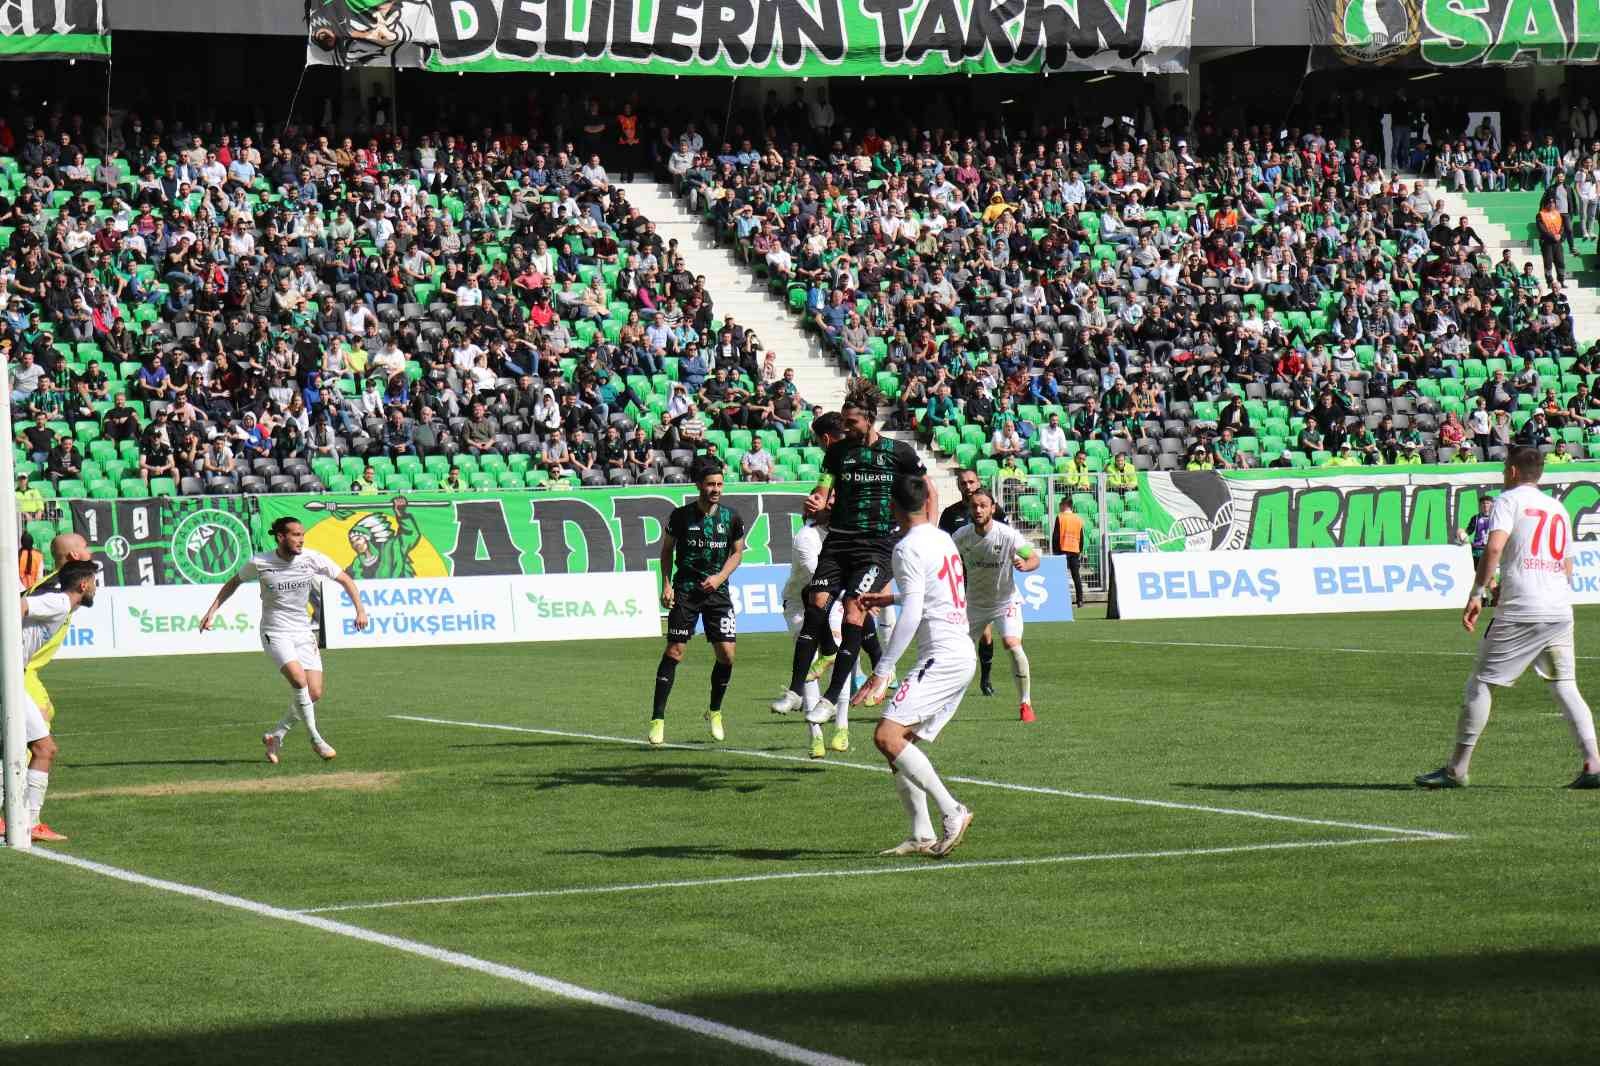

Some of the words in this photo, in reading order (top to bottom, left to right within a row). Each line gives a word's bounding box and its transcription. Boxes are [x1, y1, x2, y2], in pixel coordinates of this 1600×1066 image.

[1524, 508, 1566, 560] 70
[1138, 568, 1281, 602] BELPAŞ
[1313, 563, 1455, 596] BELPAŞ
[340, 588, 454, 607] SAKARYA
[538, 600, 596, 618] SERA
[603, 599, 643, 618] A.Ş.
[140, 615, 204, 633] SERA
